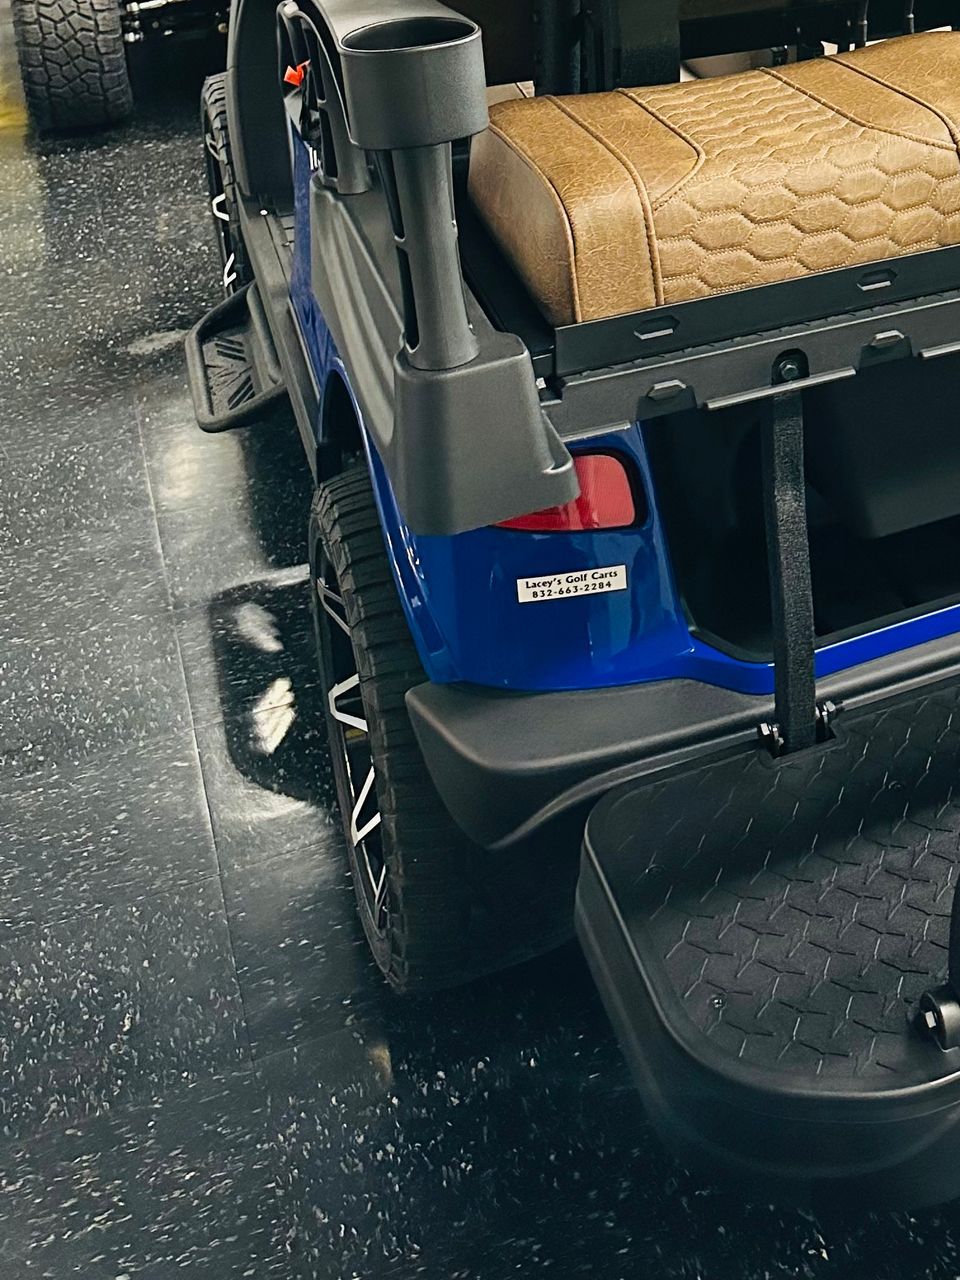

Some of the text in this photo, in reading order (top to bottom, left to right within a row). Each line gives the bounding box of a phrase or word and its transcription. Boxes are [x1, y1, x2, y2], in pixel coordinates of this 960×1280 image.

[526, 570, 618, 590] Lacey's Golf Carts
[532, 581, 612, 598] 832-663-2284
